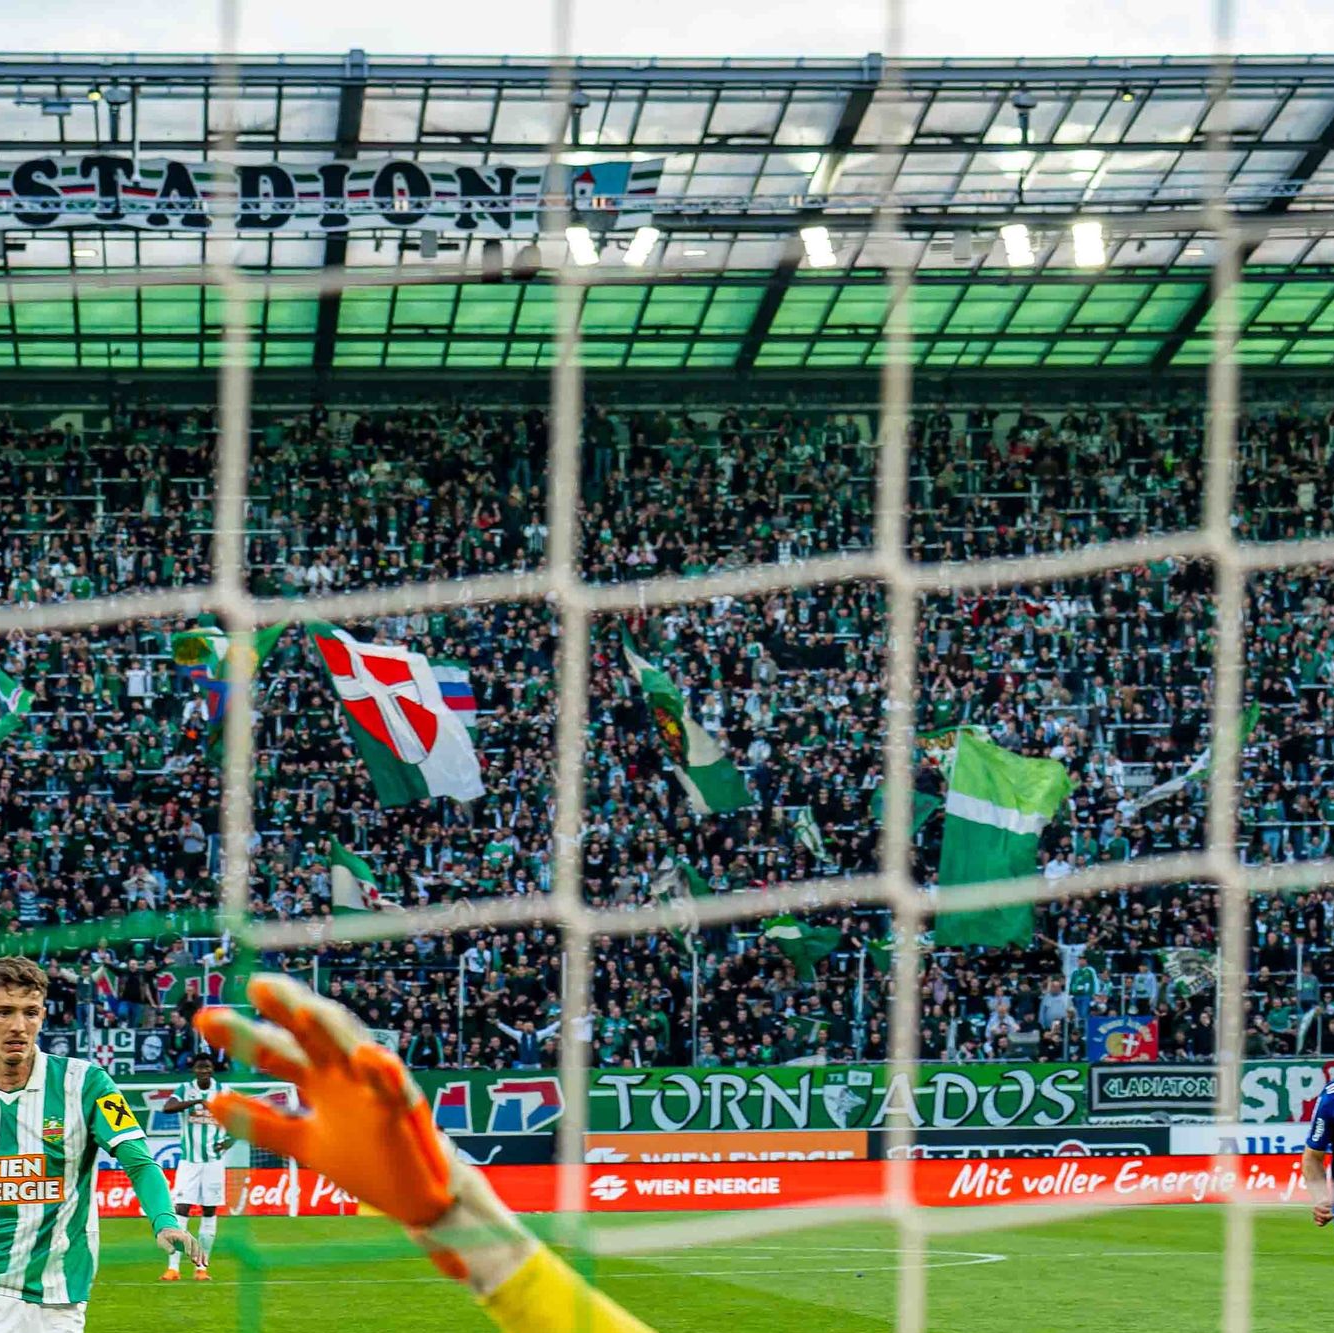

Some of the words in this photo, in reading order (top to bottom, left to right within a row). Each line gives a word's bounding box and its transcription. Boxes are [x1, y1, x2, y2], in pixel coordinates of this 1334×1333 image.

[634, 1178, 690, 1196] WIEN
[693, 1176, 779, 1195] ENERGIE
[948, 1162, 1013, 1198] Mit
[1022, 1161, 1107, 1196] voller
[1113, 1160, 1237, 1201] Energie
[1246, 1164, 1275, 1191] in
